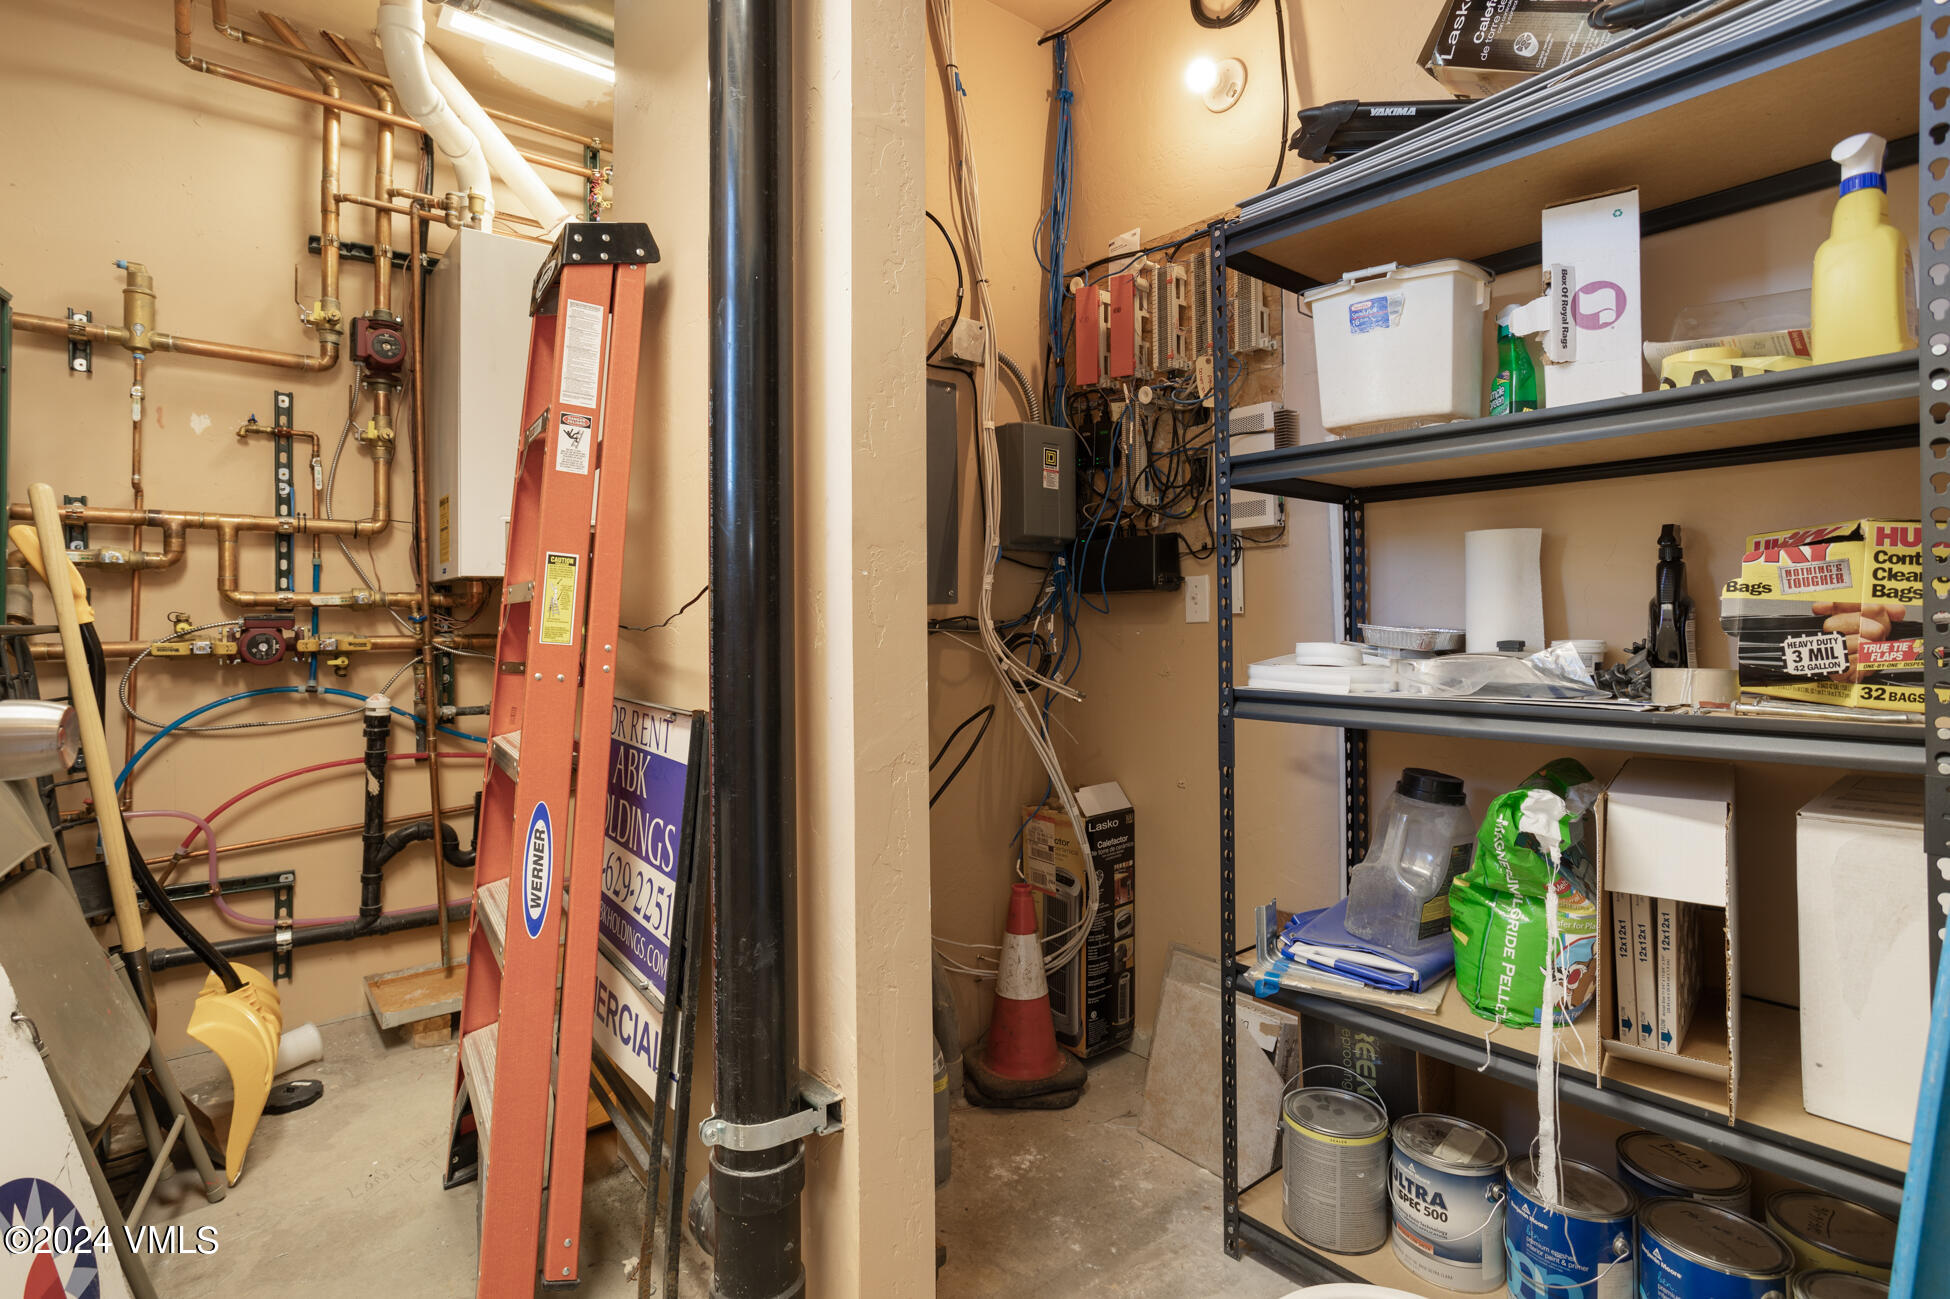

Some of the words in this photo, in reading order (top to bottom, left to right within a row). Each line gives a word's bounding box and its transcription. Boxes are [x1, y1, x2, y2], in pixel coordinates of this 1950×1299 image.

[1440, 0, 1472, 59] Lask
[1481, 45, 1490, 61] de
[1370, 107, 1416, 117] YAKIMA
[1561, 288, 1569, 299] Of
[1561, 301, 1569, 325] Royal
[1561, 326, 1569, 349] Rags
[1784, 563, 1843, 579] NOTHING'S
[1726, 580, 1773, 596] Bags
[1786, 572, 1845, 590] TOUGHER
[1872, 583, 1923, 602] Bags
[1787, 640, 1814, 649] HEAVY
[1816, 637, 1838, 646] DUTY
[1863, 644, 1891, 653] TRUE
[1893, 642, 1910, 651] TIE
[1792, 649, 1803, 663] 3
[1808, 646, 1838, 662] MIL
[1870, 652, 1904, 661] FLAPS
[1807, 661, 1841, 671] GALLON
[1860, 687, 1887, 701] 32
[1888, 692, 1925, 703] BAGS
[611, 704, 626, 739] OR
[630, 710, 674, 754] RENT
[613, 745, 651, 798] ABK
[605, 794, 675, 873] LDINGS
[1088, 819, 1119, 833] Lasko
[530, 828, 546, 909] WERNER
[599, 901, 668, 981] BKHOLDINGS.COM
[1618, 919, 1628, 958] 12x12x1
[1661, 912, 1671, 952] 12x12x1
[1638, 924, 1647, 963] 12x12x1
[596, 976, 660, 1073] ERCIAL
[1399, 1190, 1421, 1213] SPEC
[1424, 1206, 1448, 1223] 500
[1544, 1253, 1560, 1264] paint
[1568, 1263, 1589, 1273] primer
[1660, 1261, 1682, 1279] Moore
